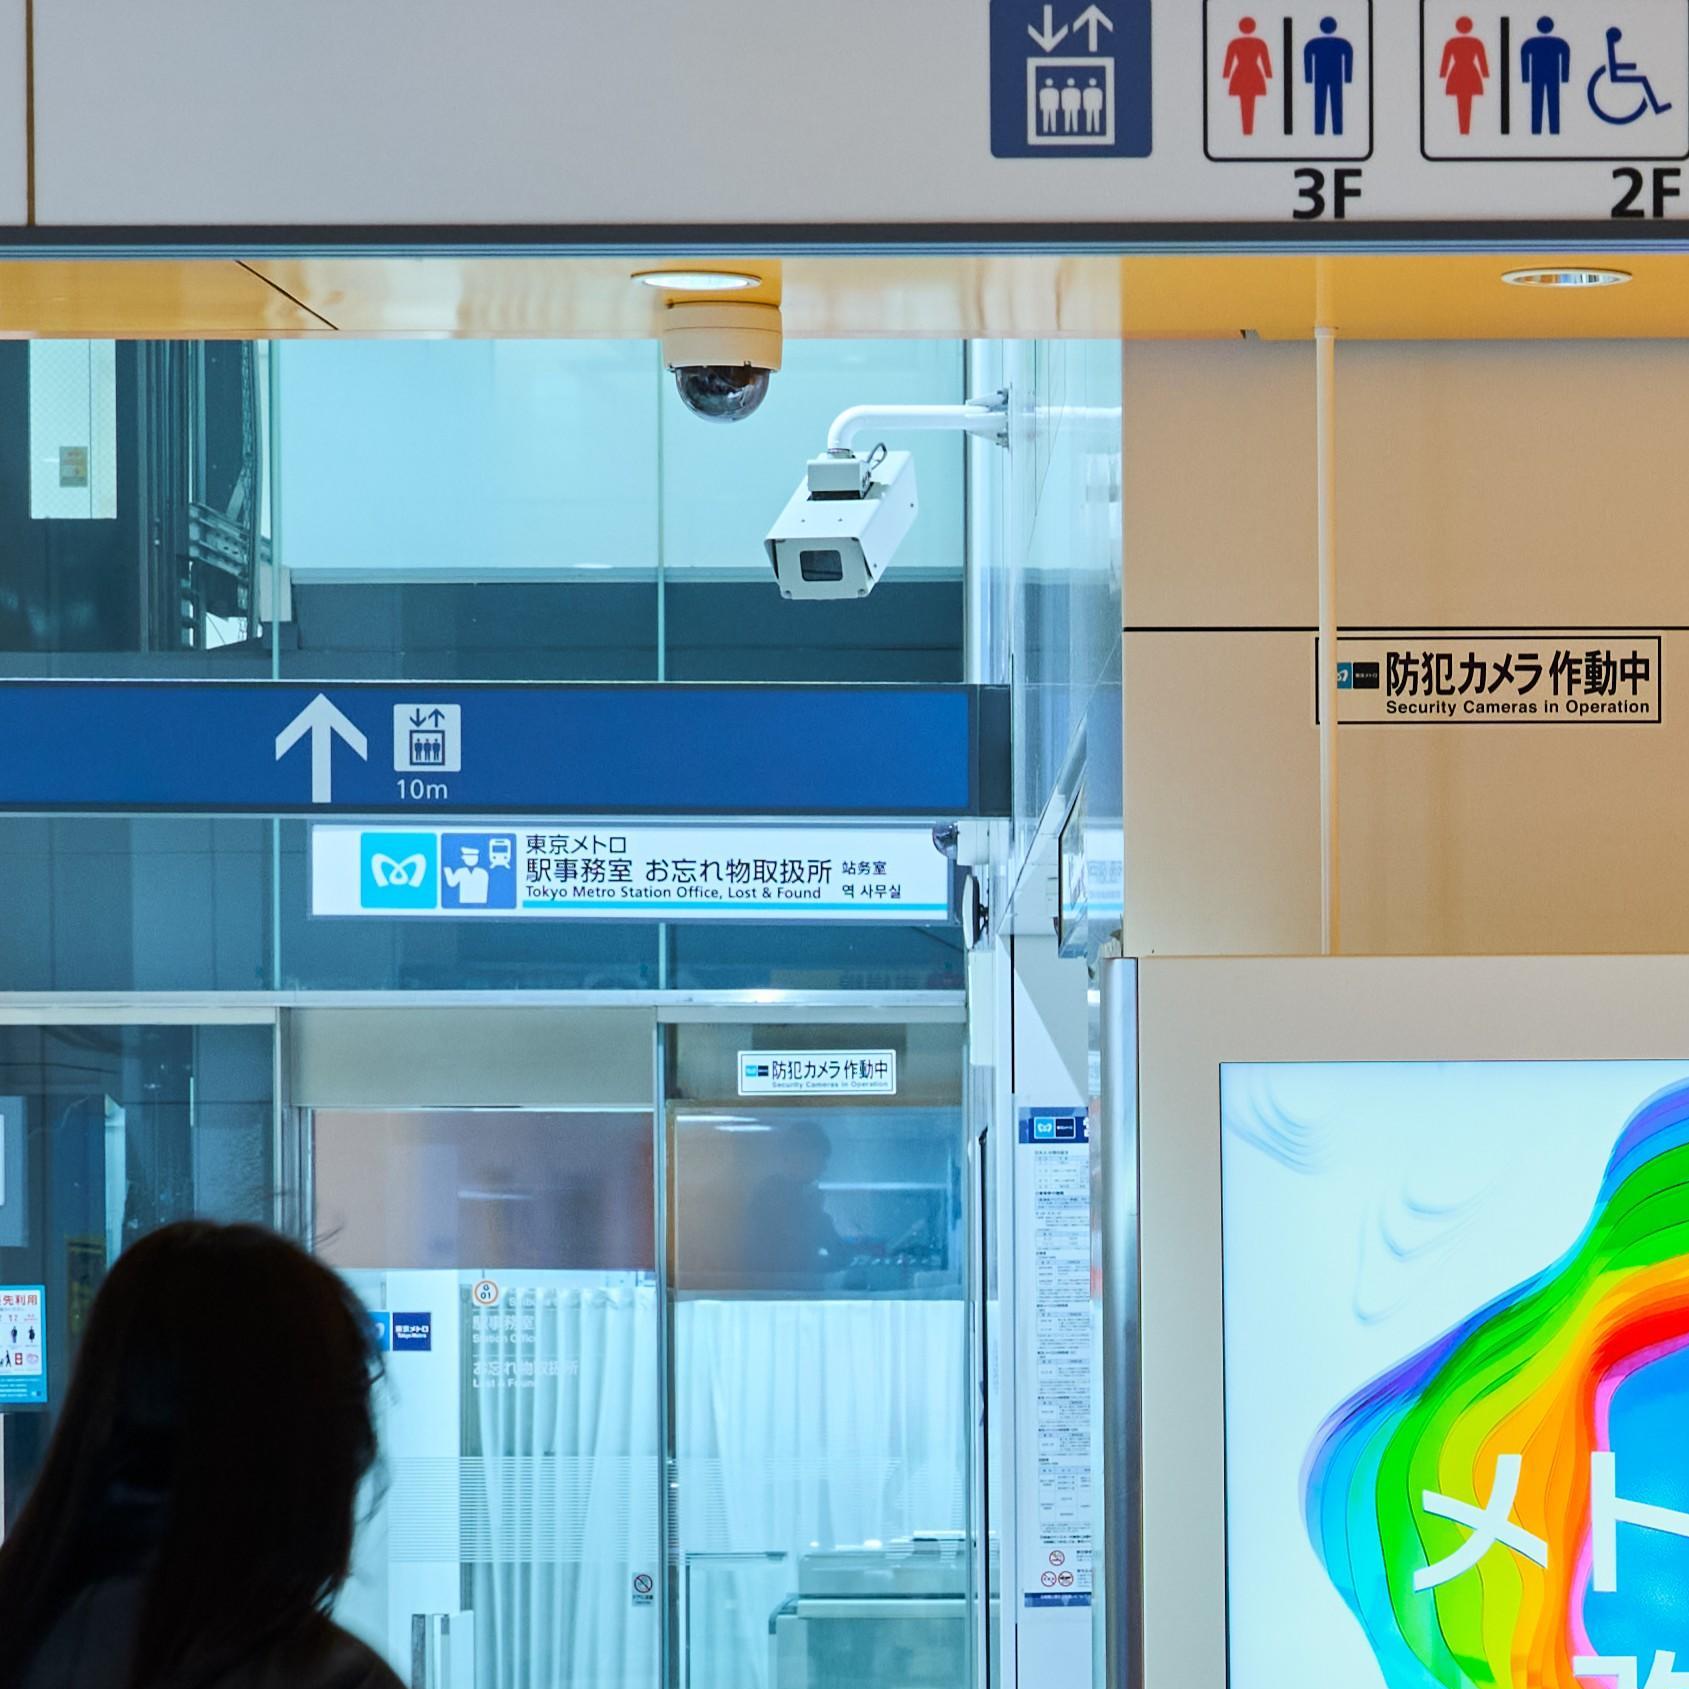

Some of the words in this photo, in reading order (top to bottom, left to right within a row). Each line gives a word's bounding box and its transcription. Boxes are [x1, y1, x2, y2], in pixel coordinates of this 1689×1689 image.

[1292, 167, 1362, 219] 3F
[1611, 167, 1681, 219] 2F
[1386, 650, 1650, 696] 防犯カメラ作動中
[1386, 700, 1456, 716] Security
[1463, 700, 1537, 714] Cameras
[1544, 700, 1559, 713] in
[1566, 699, 1650, 716] Operation
[397, 779, 448, 799] 10m
[526, 834, 626, 855] 東京メトロ
[526, 858, 633, 883] 駅事務室
[646, 858, 832, 884] お忘れ物取扱所
[526, 886, 567, 900] Tokyo
[573, 886, 616, 898] Metro
[621, 886, 671, 898] Station
[677, 885, 722, 900] Office,
[729, 887, 757, 899] Lost
[762, 887, 772, 899] &
[777, 886, 821, 899] Found
[842, 884, 854, 899] 역
[861, 884, 901, 899] 사무실
[772, 1060, 888, 1080] 防犯カメラ作動中
[0, 1295, 38, 1306] 先利用
[480, 1292, 491, 1300] 01
